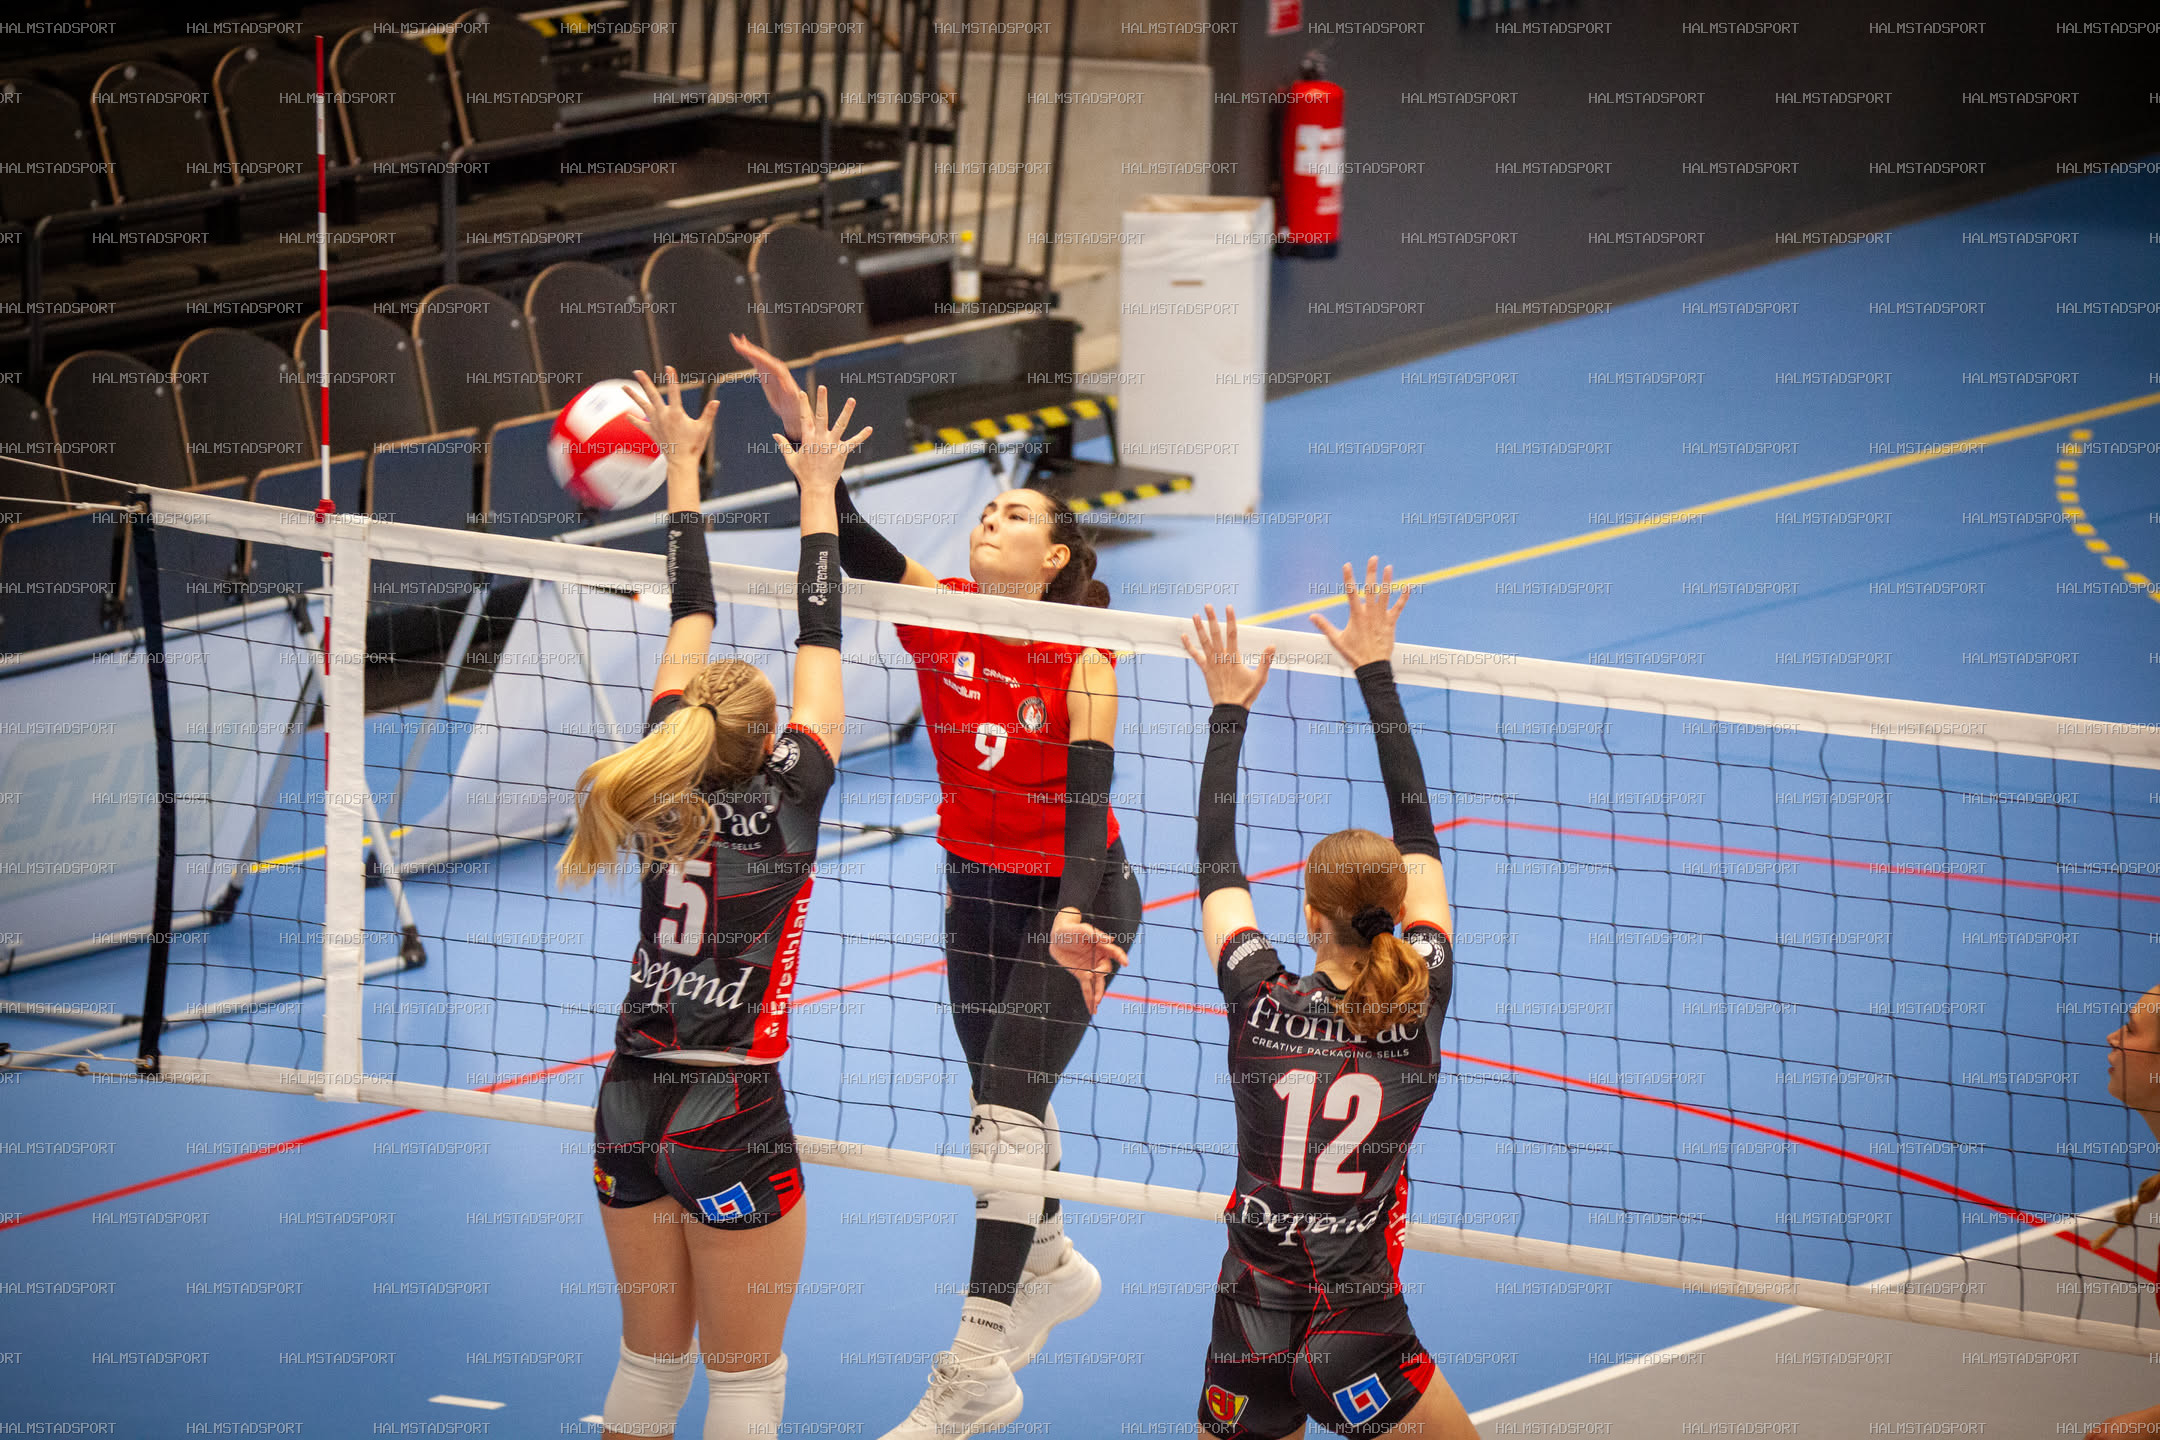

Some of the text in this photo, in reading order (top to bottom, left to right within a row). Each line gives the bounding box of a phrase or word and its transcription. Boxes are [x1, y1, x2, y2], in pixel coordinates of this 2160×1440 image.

[816, 551, 829, 594] adrenalina
[943, 677, 981, 700] stadium
[975, 722, 1008, 772] 9
[659, 857, 712, 957] 5
[630, 948, 754, 1009] Depend
[1248, 994, 1424, 1044] Frontac
[1252, 1035, 1409, 1059] CREATIVE PACKAGING SELLS
[1272, 1069, 1384, 1195] 12
